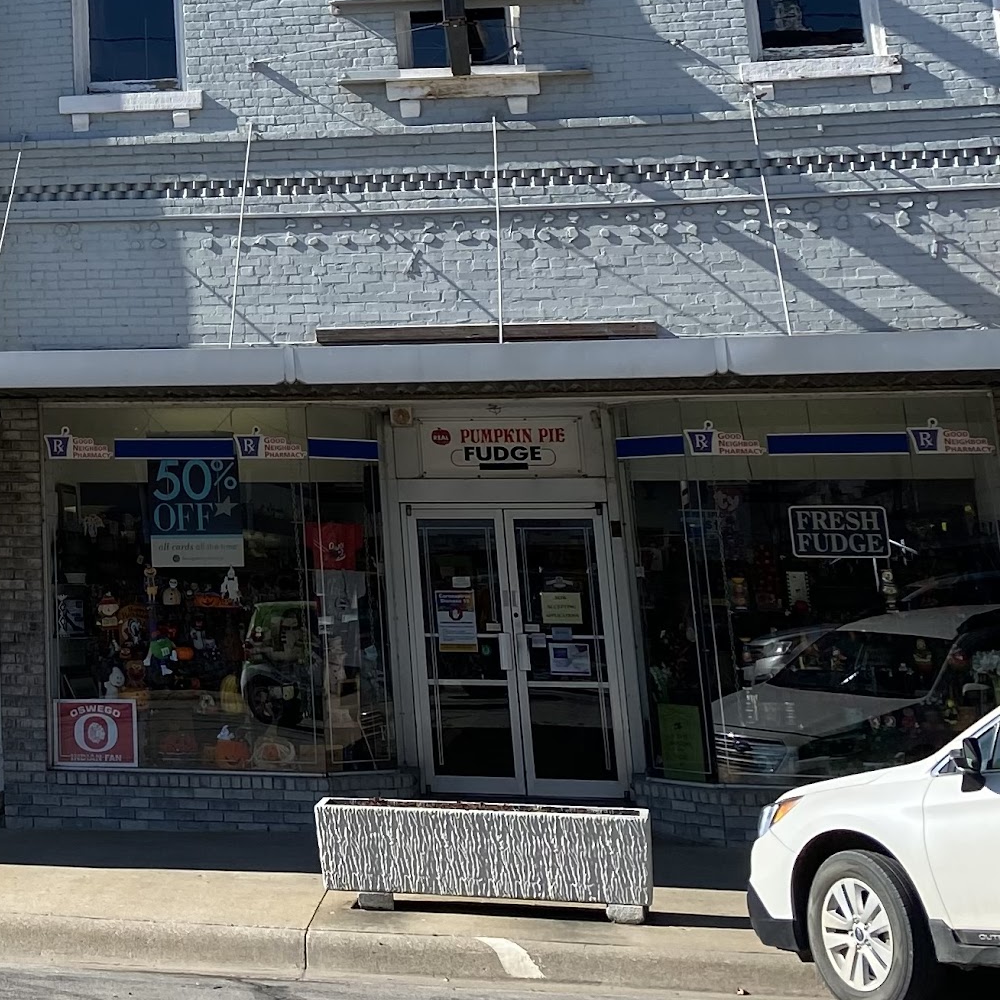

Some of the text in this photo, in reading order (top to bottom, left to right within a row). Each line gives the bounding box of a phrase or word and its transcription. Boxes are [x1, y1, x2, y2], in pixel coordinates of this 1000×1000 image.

[460, 427, 565, 443] PUMPKIN PIE
[464, 446, 541, 461] FUDGE
[719, 447, 763, 455] PHARMACY
[153, 459, 237, 501] 50%
[154, 502, 215, 532] OFF
[795, 510, 880, 530] FRESH
[172, 543, 193, 551] cards
[796, 533, 884, 553] FUDGE
[70, 705, 121, 718] OSWEGO
[70, 753, 103, 761] INDIAN
